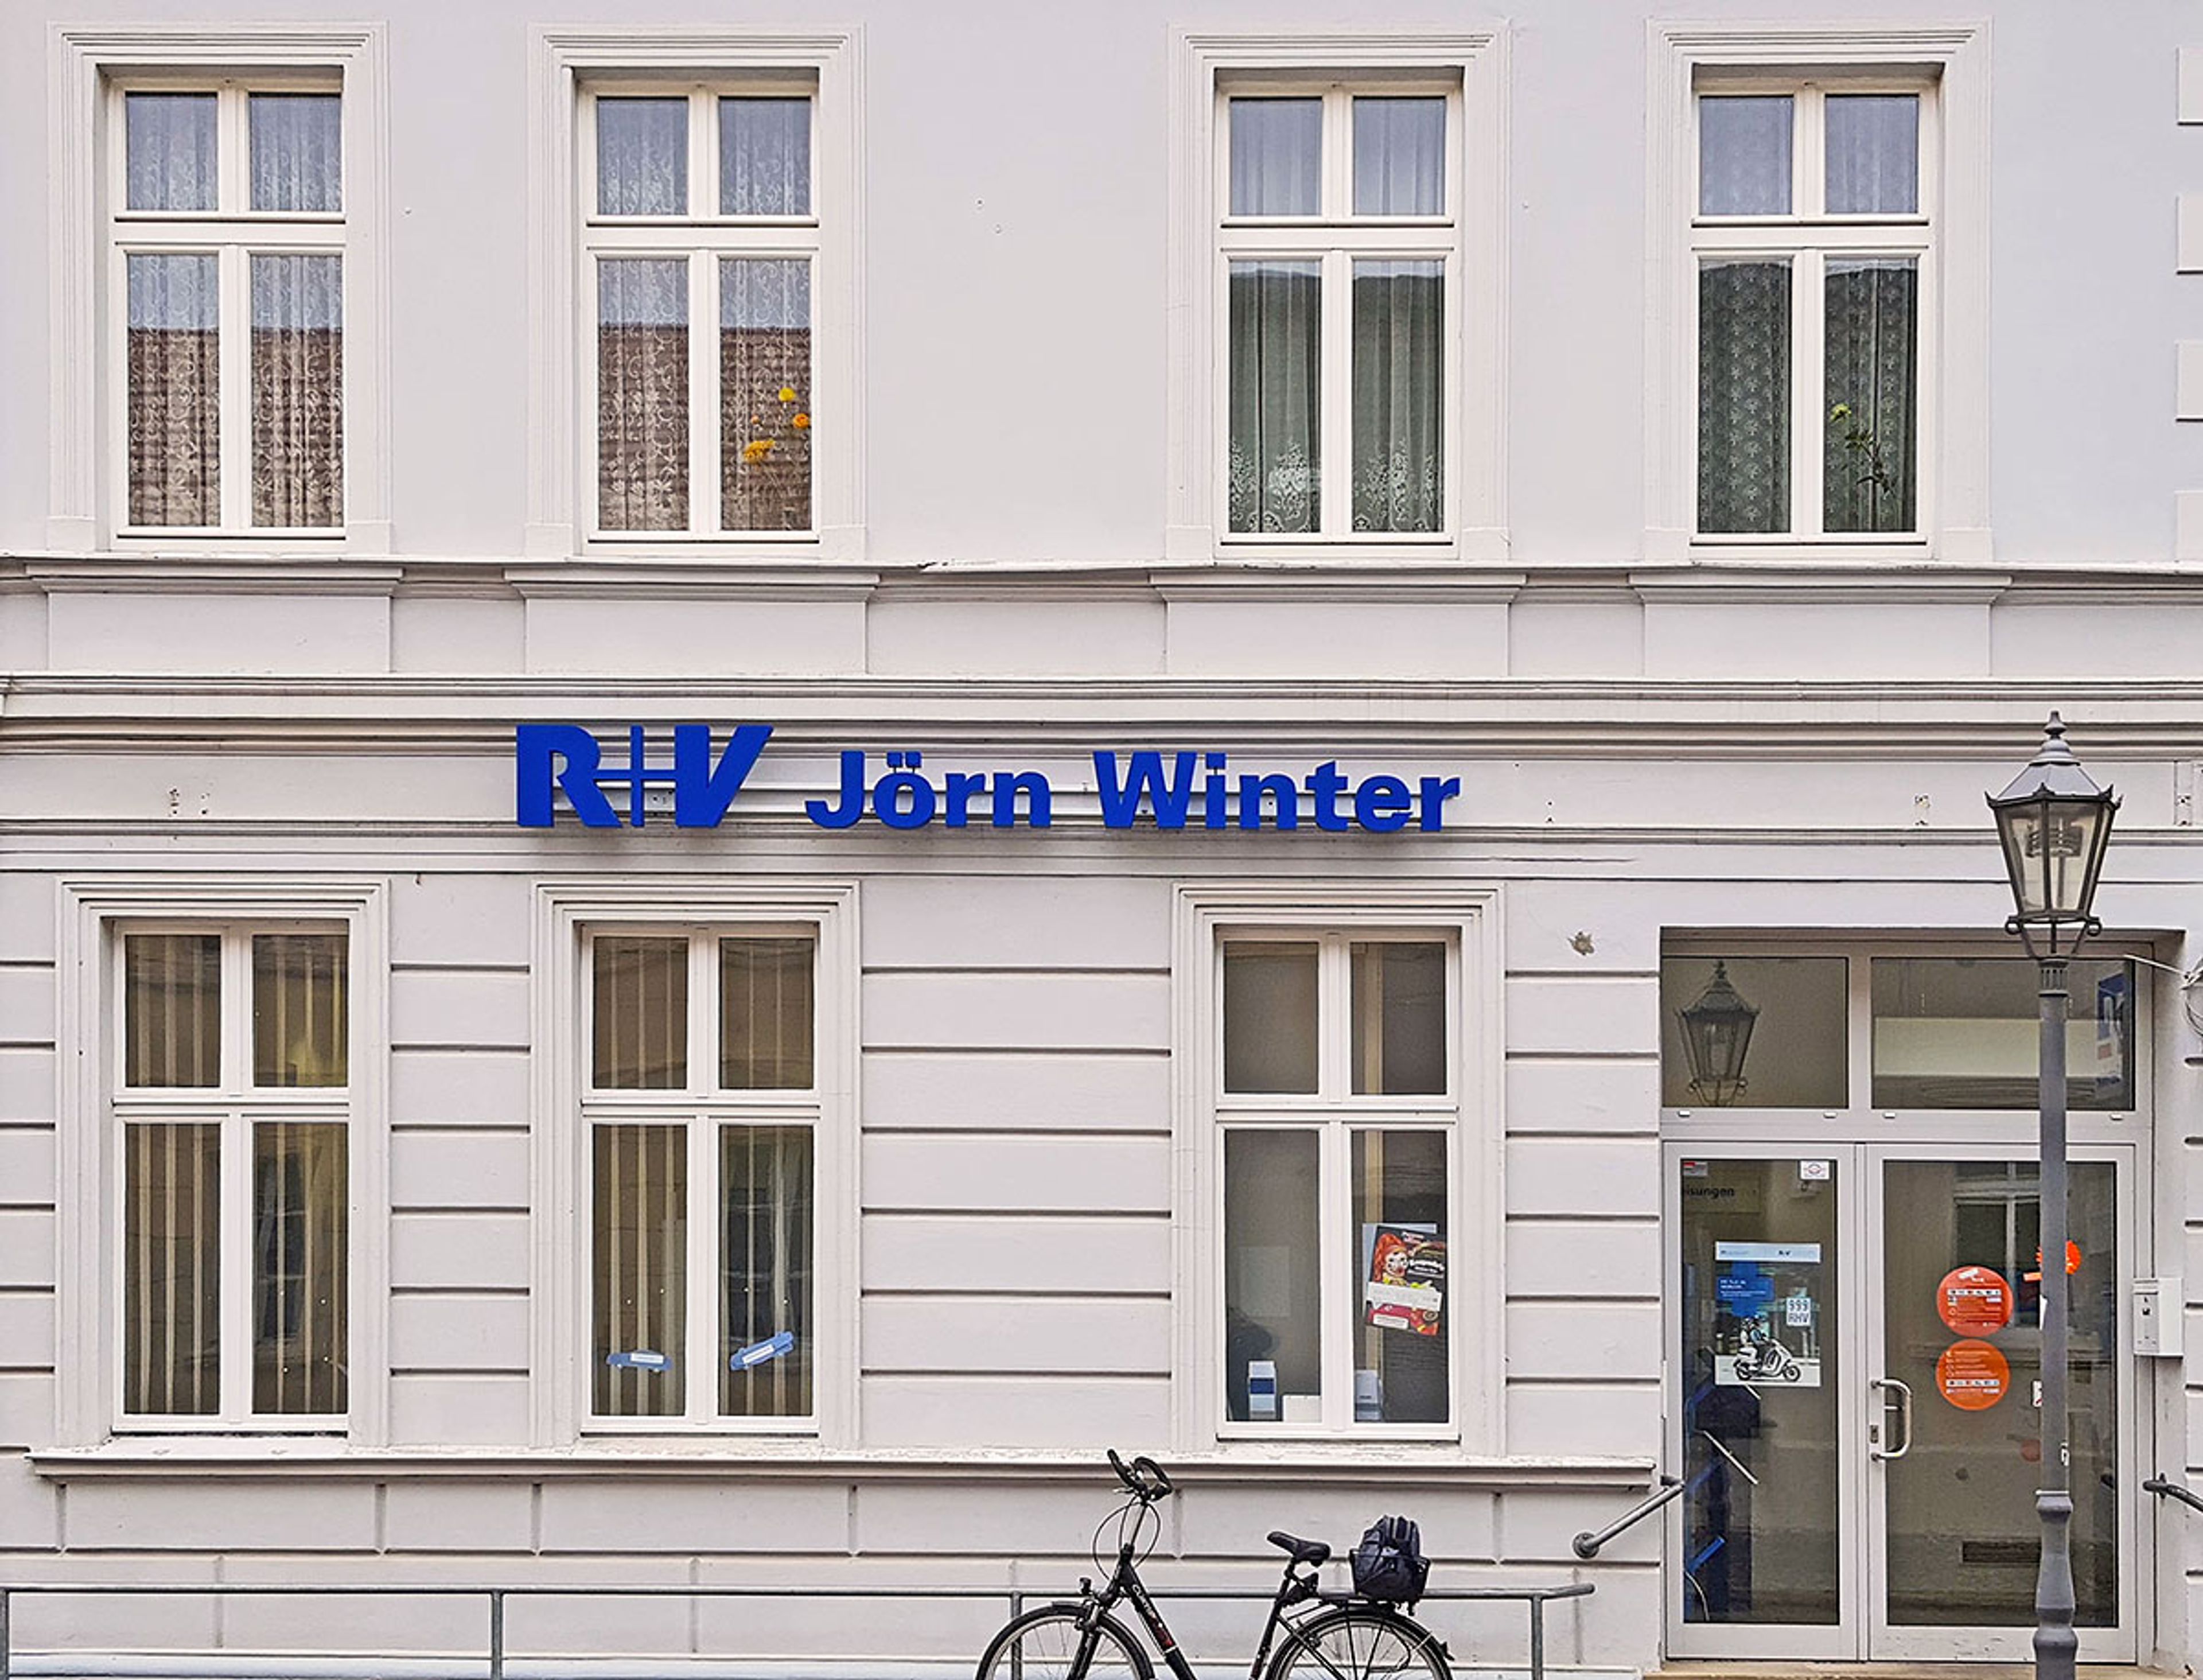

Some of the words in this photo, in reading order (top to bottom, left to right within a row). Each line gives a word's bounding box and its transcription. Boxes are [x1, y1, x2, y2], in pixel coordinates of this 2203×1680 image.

[516, 724, 773, 827] R+V
[806, 750, 1051, 829] Jörn
[1093, 750, 1460, 831] Winter
[1687, 1186, 1735, 1200] sungen
